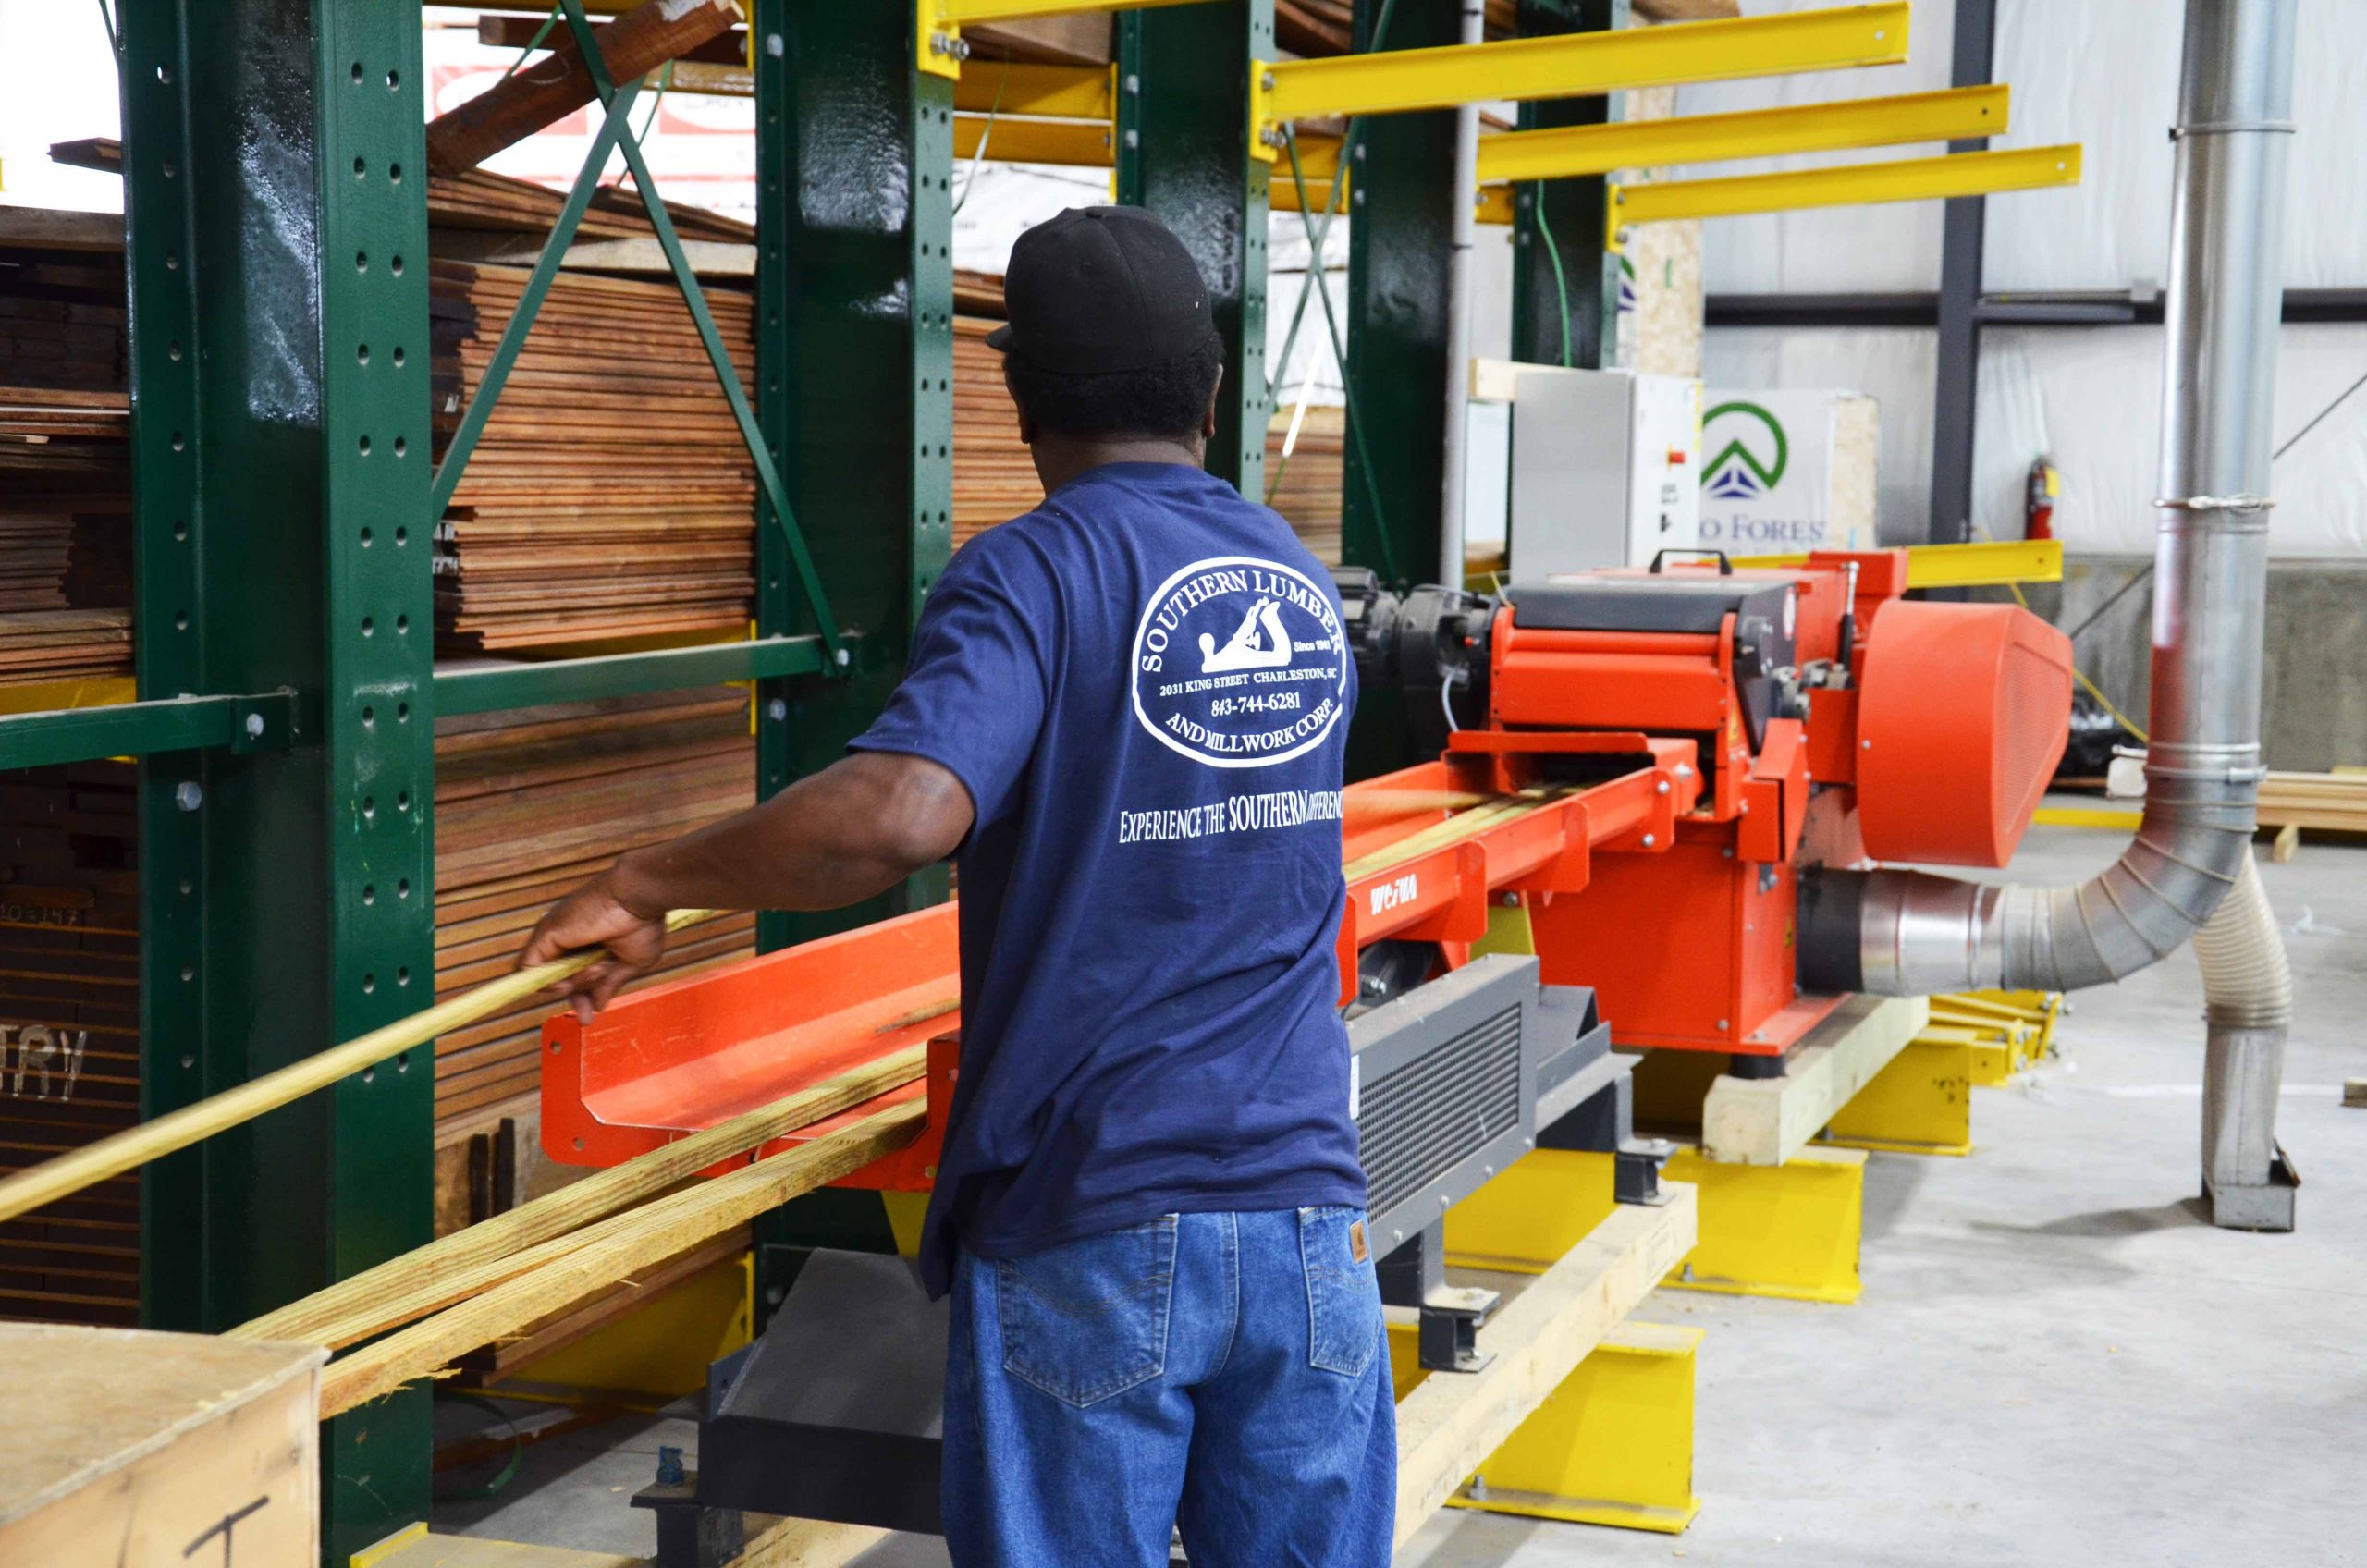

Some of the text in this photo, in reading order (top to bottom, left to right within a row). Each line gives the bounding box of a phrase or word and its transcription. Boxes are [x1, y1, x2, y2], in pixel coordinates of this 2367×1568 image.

[1141, 570, 1342, 673] SOUTHERN LUMBER
[1294, 641, 1315, 652] Since
[1159, 668, 1337, 696] 2031 KING STREET CHARLESTON, SC
[1211, 692, 1301, 717] 843-744-6281
[1166, 700, 1333, 753] AND MILLWORK CORP.
[1119, 810, 1202, 843] EXPERIENCE
[1204, 803, 1226, 836] THE
[1229, 790, 1308, 832] SOUTHERN
